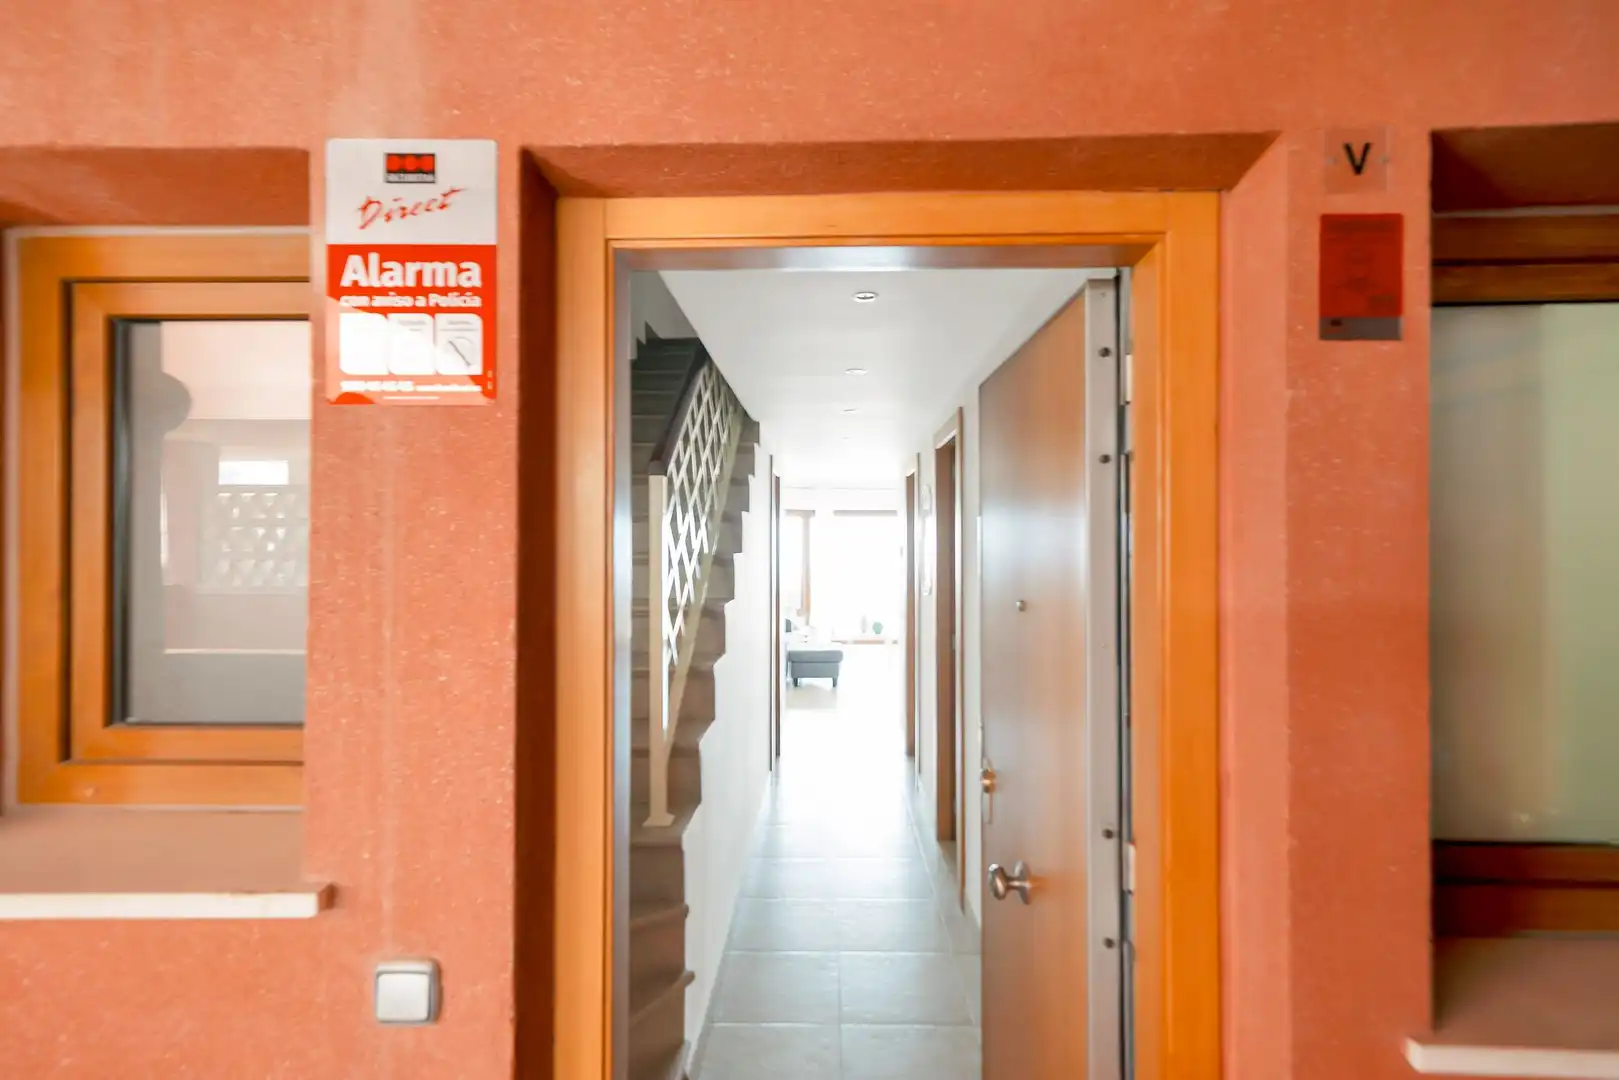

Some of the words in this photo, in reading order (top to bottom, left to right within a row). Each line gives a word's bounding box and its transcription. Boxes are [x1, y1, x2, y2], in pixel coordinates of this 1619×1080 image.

[1343, 142, 1372, 175] V
[356, 187, 466, 230] Direct
[340, 252, 482, 288] Alarma
[371, 291, 414, 308] aviso
[415, 296, 427, 308] a
